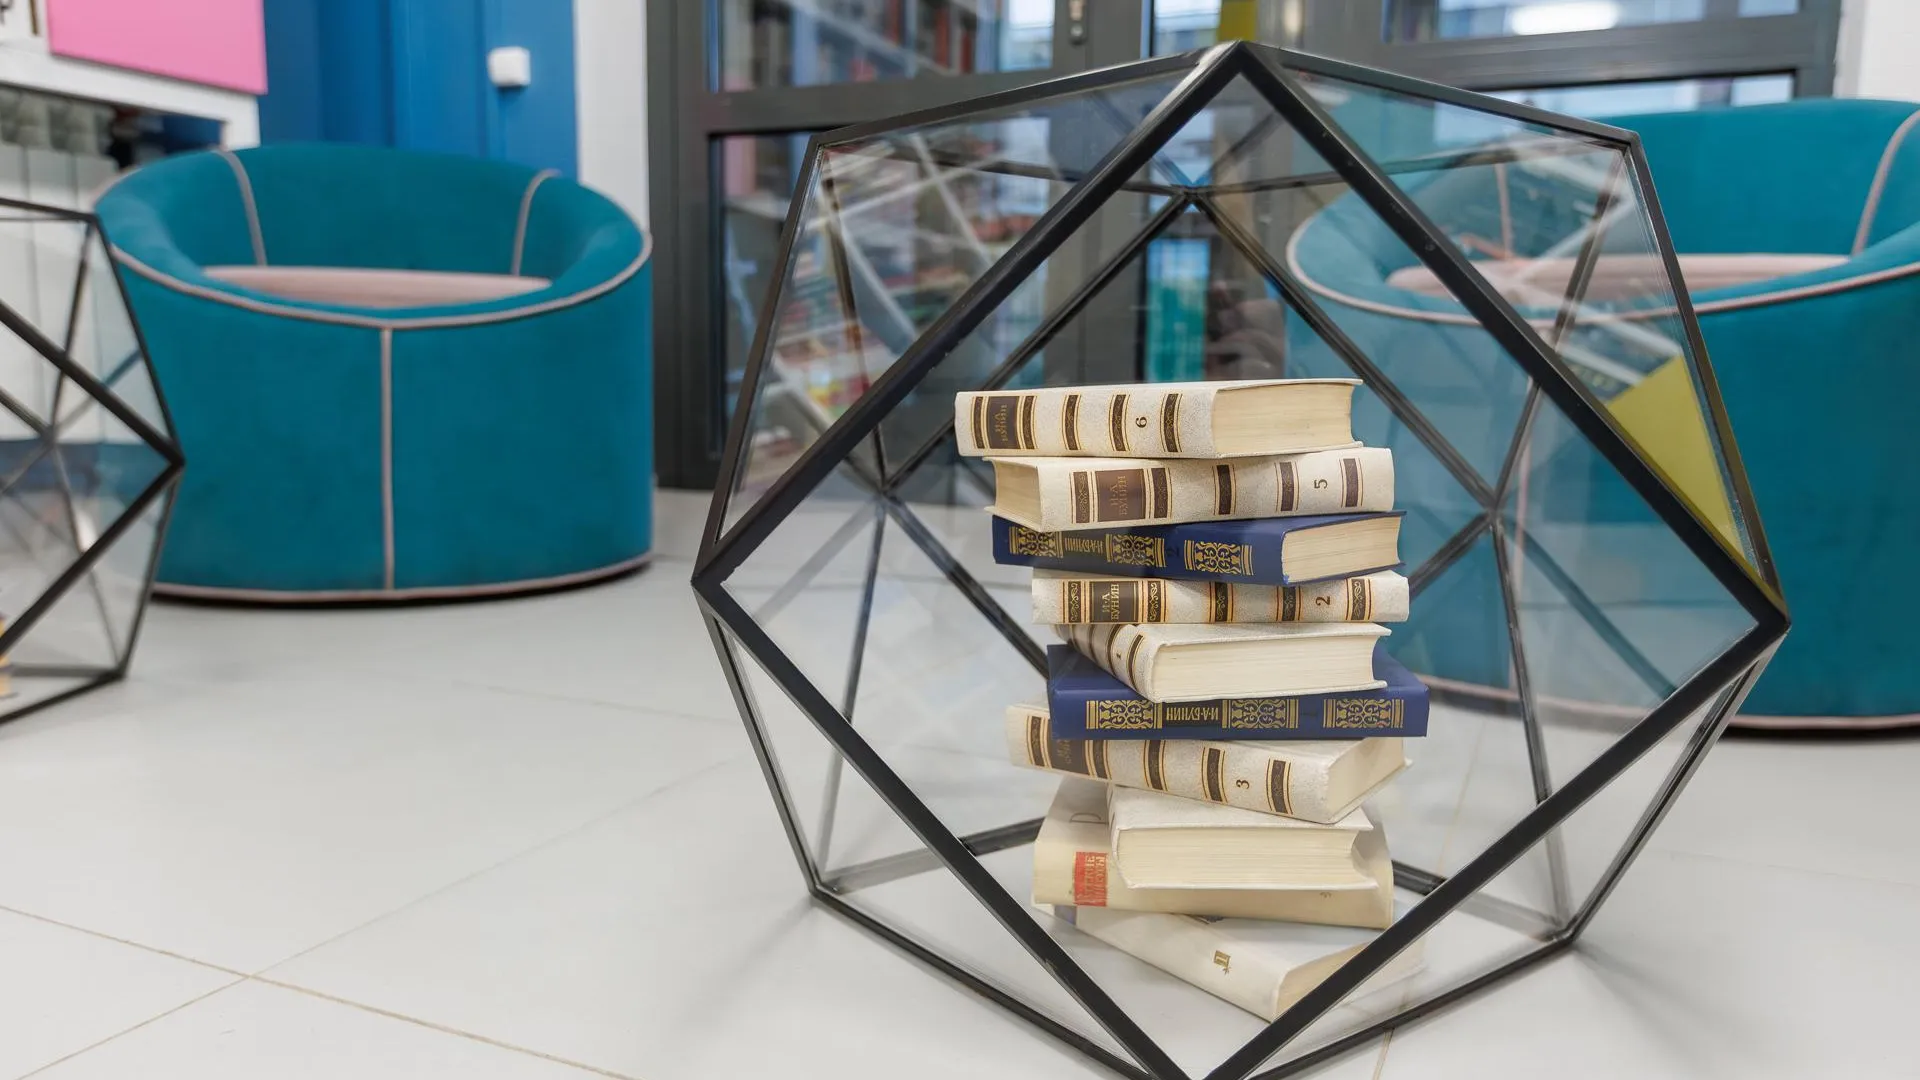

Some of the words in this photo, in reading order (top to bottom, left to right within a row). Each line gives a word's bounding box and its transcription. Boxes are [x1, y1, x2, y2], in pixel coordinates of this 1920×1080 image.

[1135, 416, 1147, 428] 6
[1313, 479, 1328, 489] 5
[1117, 475, 1128, 515] БУНИН
[1110, 584, 1120, 620] БУНИН
[1315, 596, 1331, 606] 2
[1236, 780, 1250, 790] 3
